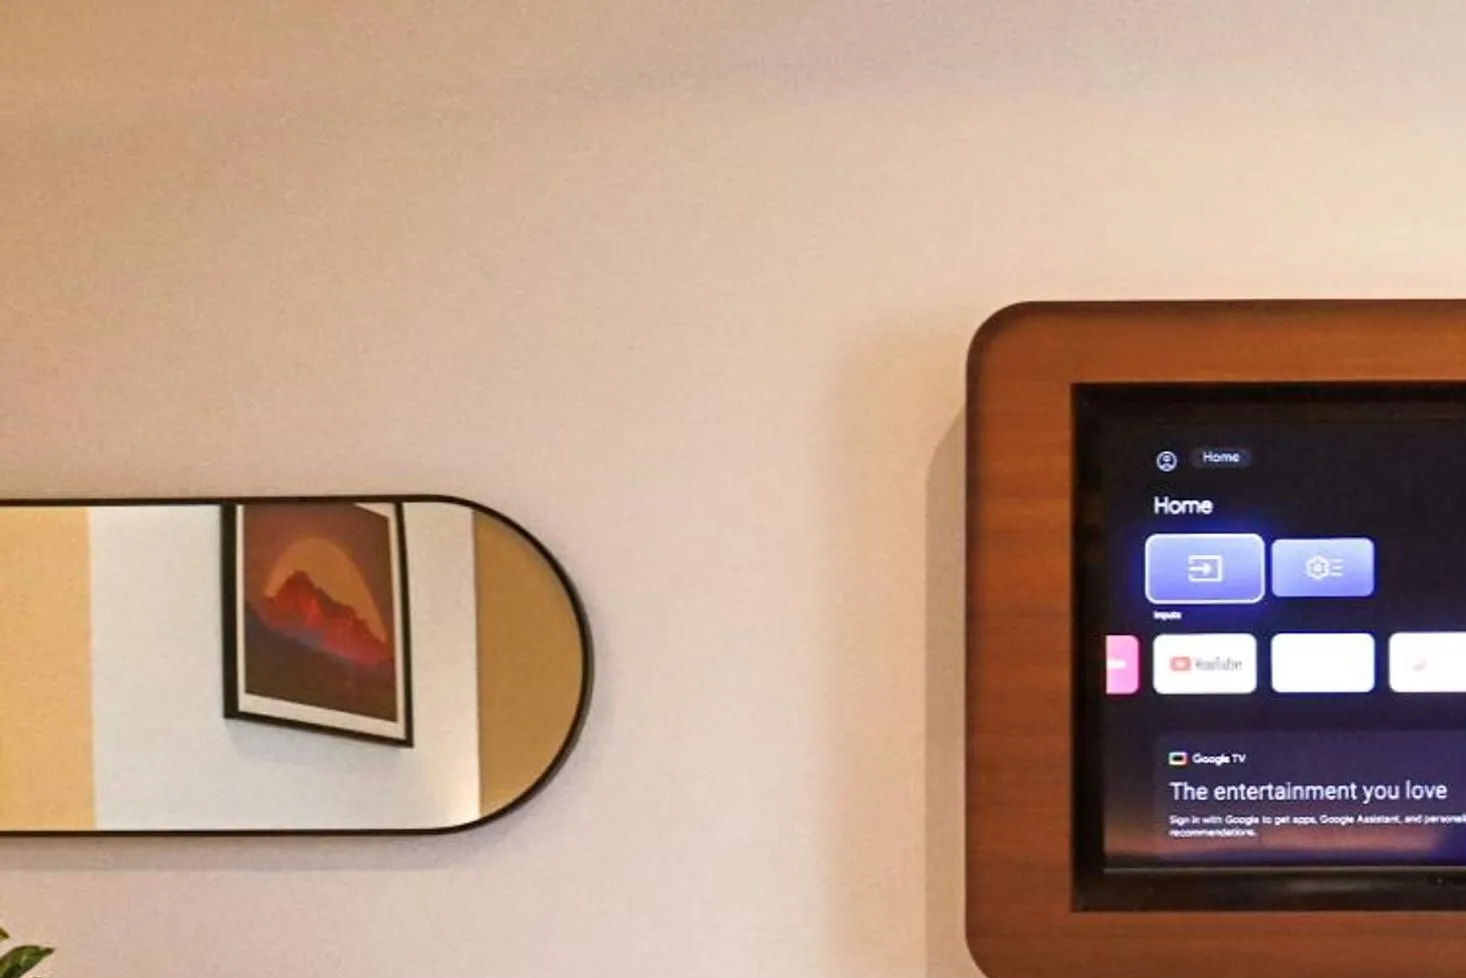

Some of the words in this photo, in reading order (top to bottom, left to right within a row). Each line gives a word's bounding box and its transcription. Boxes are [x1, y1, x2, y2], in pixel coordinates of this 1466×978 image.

[1203, 451, 1240, 463] Home
[1154, 497, 1213, 514] Home
[1192, 754, 1230, 766] Google
[1232, 754, 1246, 763] TV
[1169, 782, 1209, 800] The
[1213, 781, 1357, 801] entertainment
[1362, 785, 1400, 804] you
[1405, 780, 1448, 799] love
[1225, 815, 1259, 826] Google
[1319, 815, 1354, 825] Google
